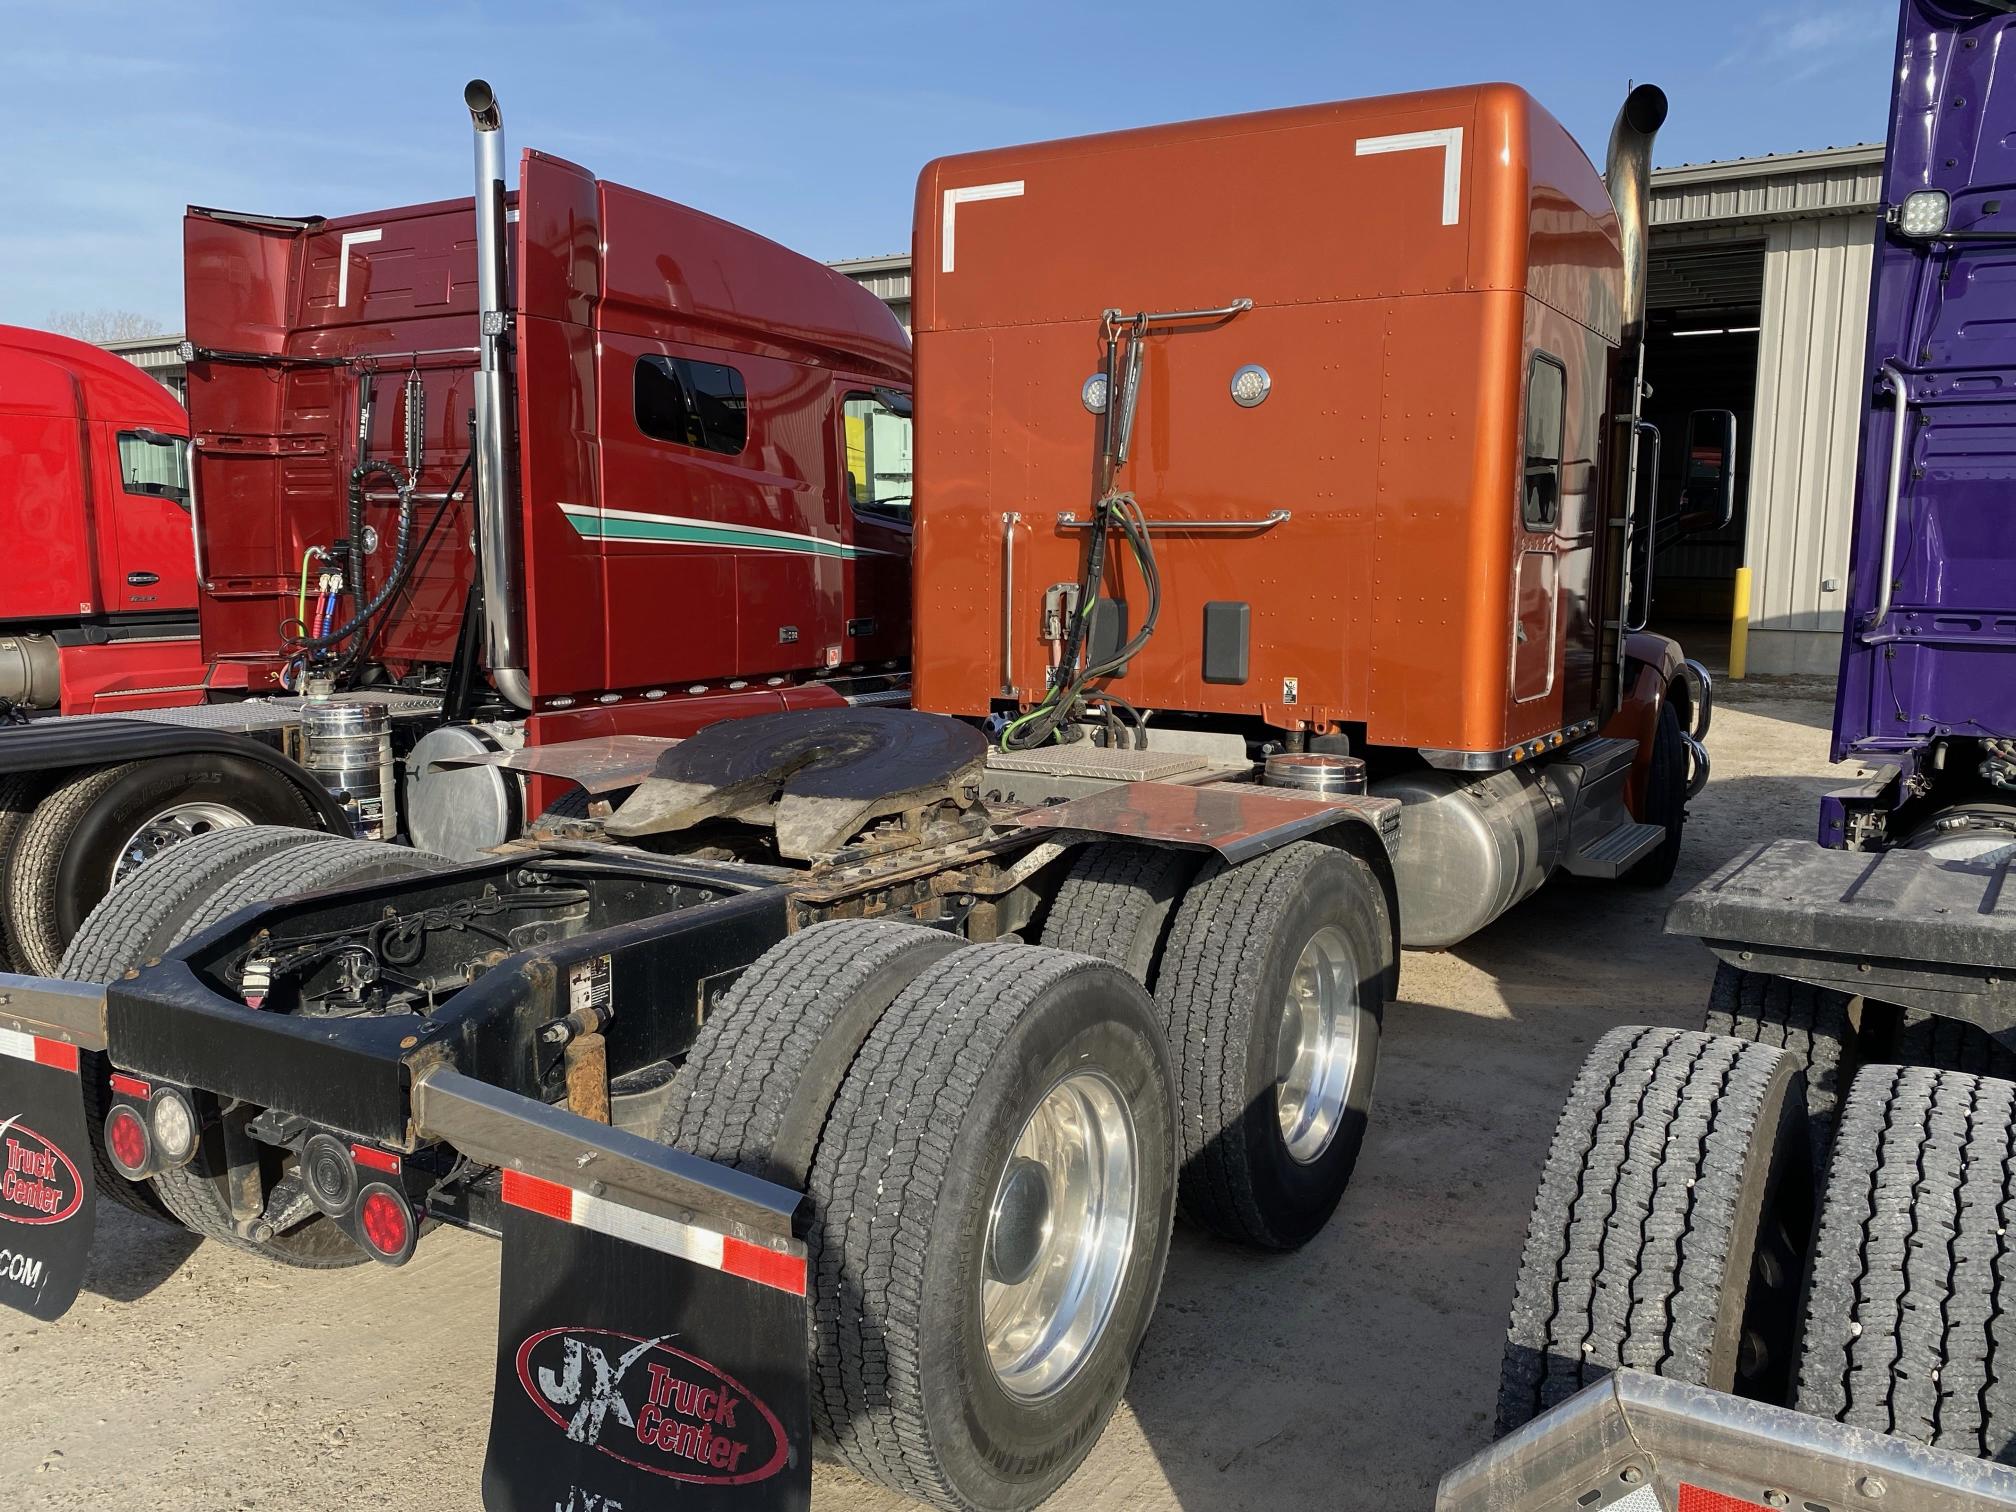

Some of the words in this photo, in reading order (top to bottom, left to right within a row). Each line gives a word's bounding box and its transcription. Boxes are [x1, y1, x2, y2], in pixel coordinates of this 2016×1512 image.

[2, 1169, 62, 1215] Center
[6, 1137, 57, 1182] Truck
[537, 1332, 681, 1447] JX
[647, 1362, 739, 1429] Truck
[636, 1403, 748, 1473] Center
